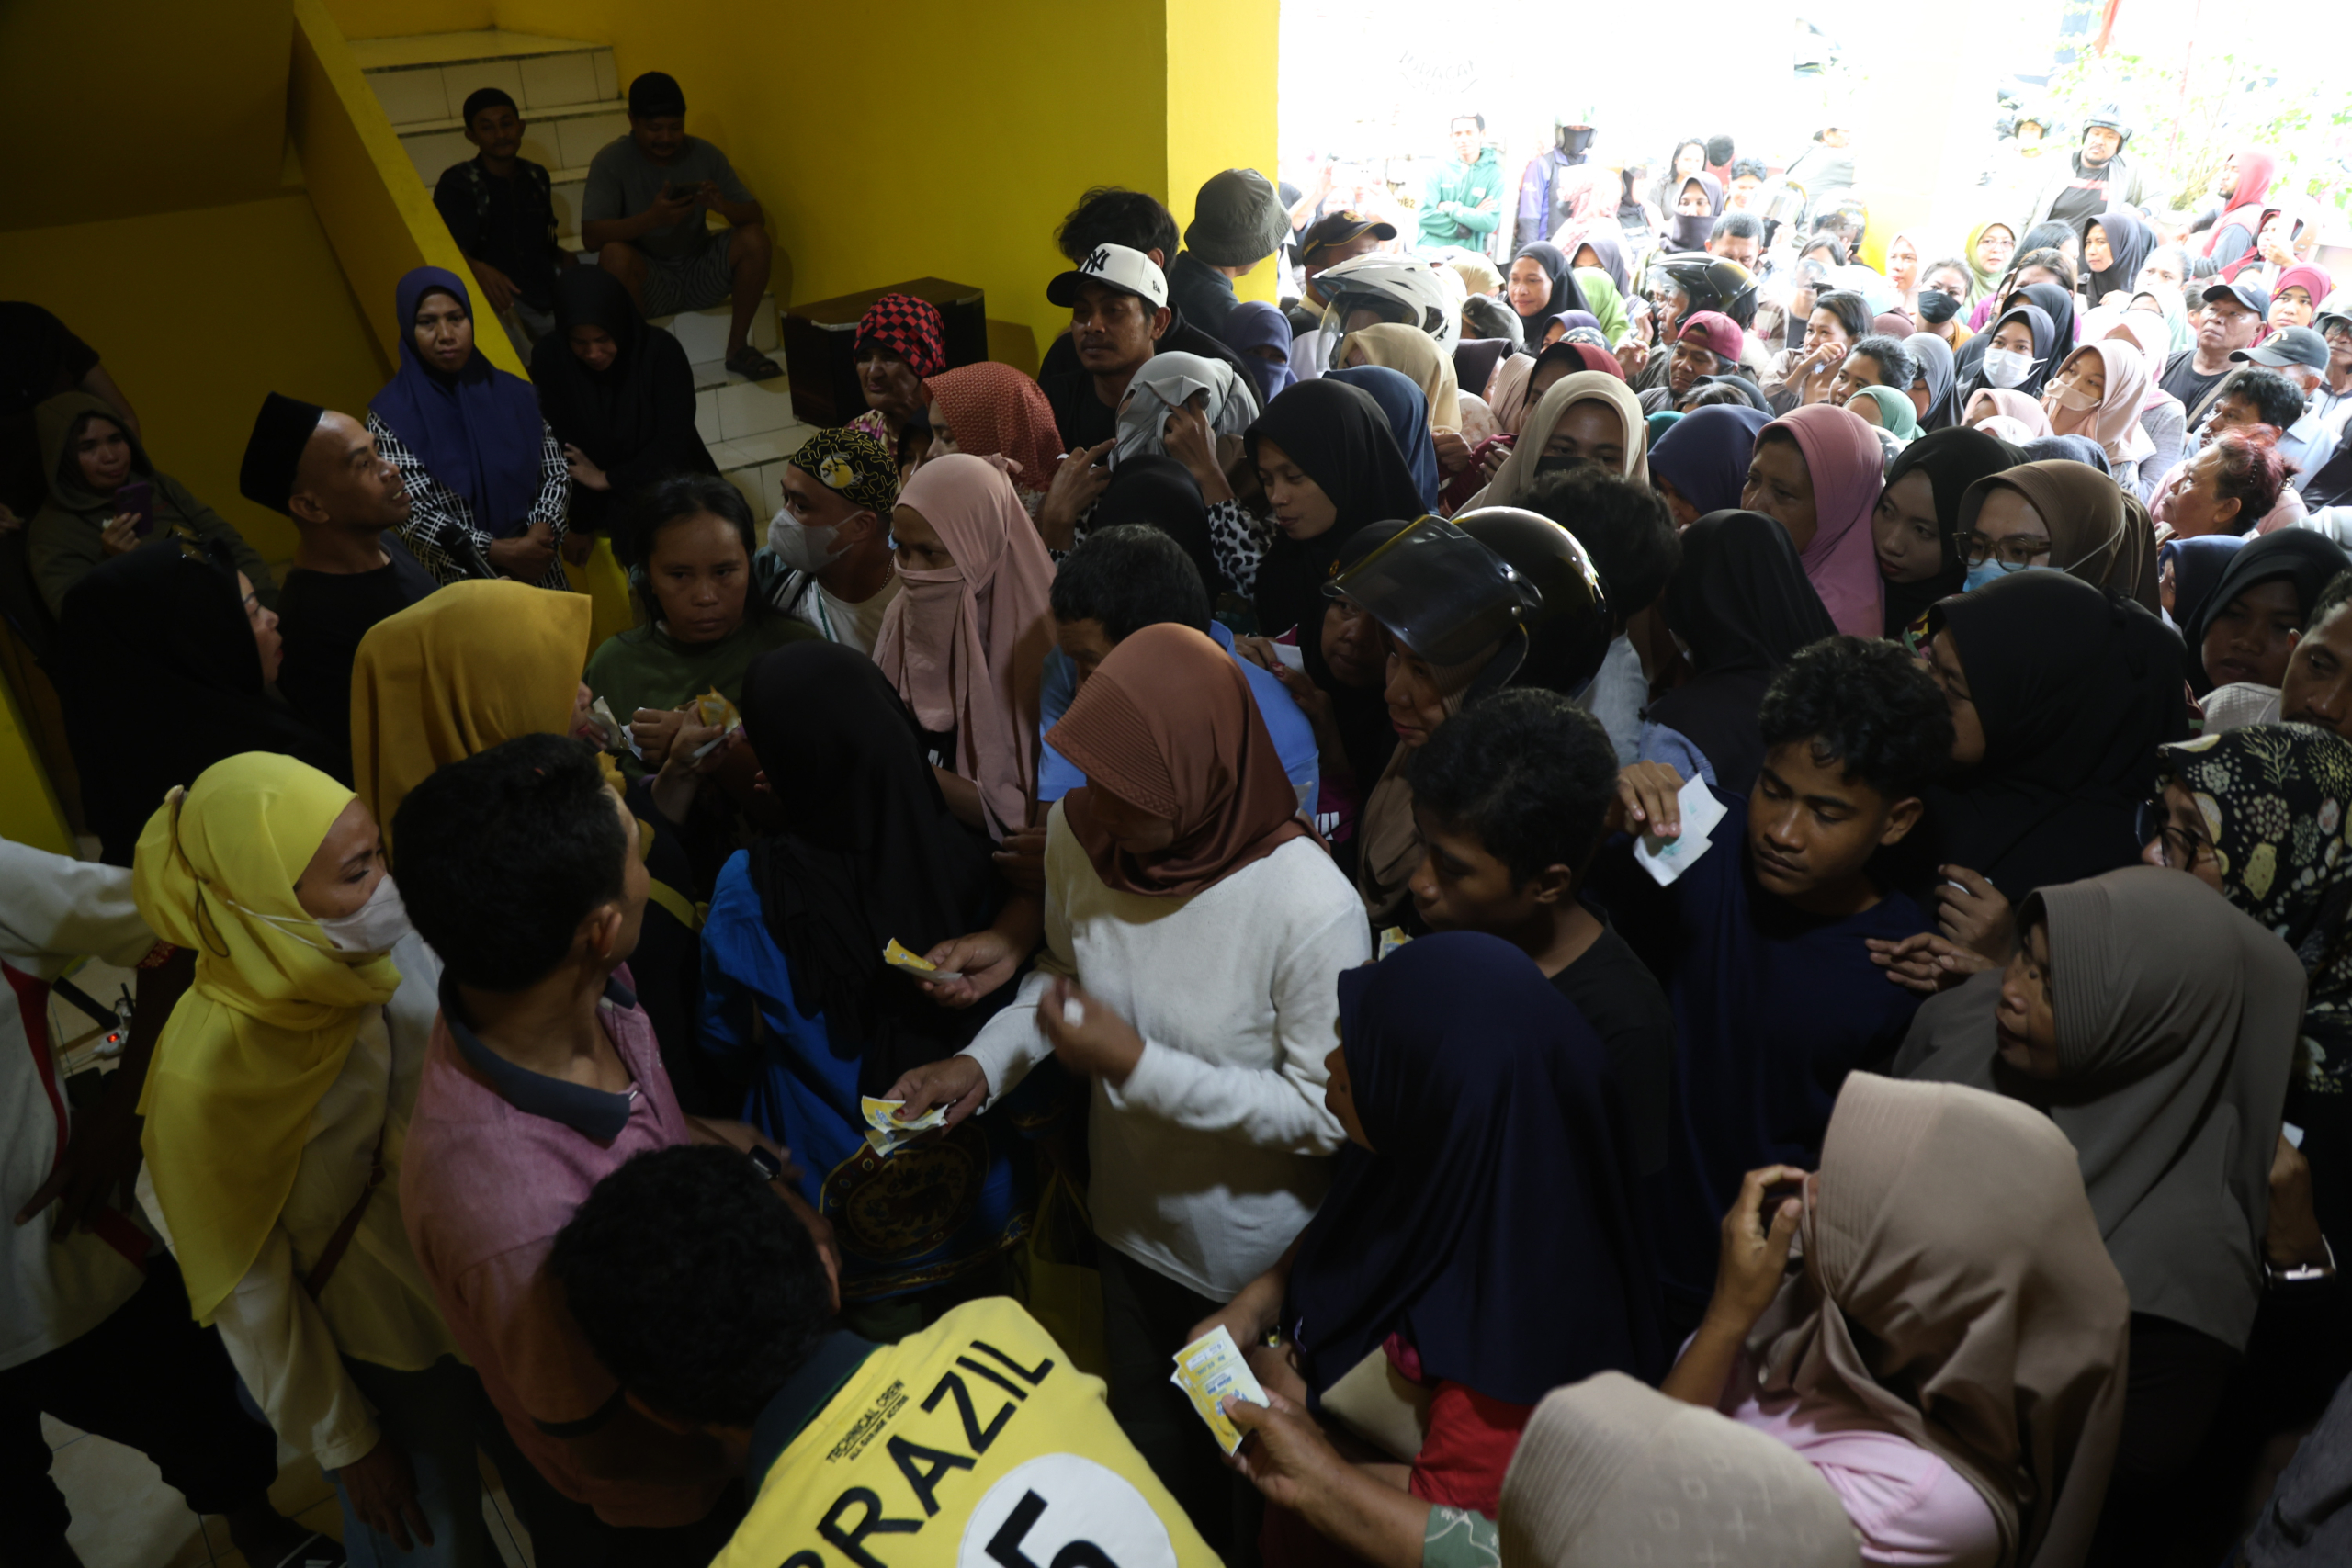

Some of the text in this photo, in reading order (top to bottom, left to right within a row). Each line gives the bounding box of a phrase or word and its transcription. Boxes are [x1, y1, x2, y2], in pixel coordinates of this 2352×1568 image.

[777, 1339, 1055, 1568] RAZIL
[826, 1379, 905, 1463] TECHNICAL CREW
